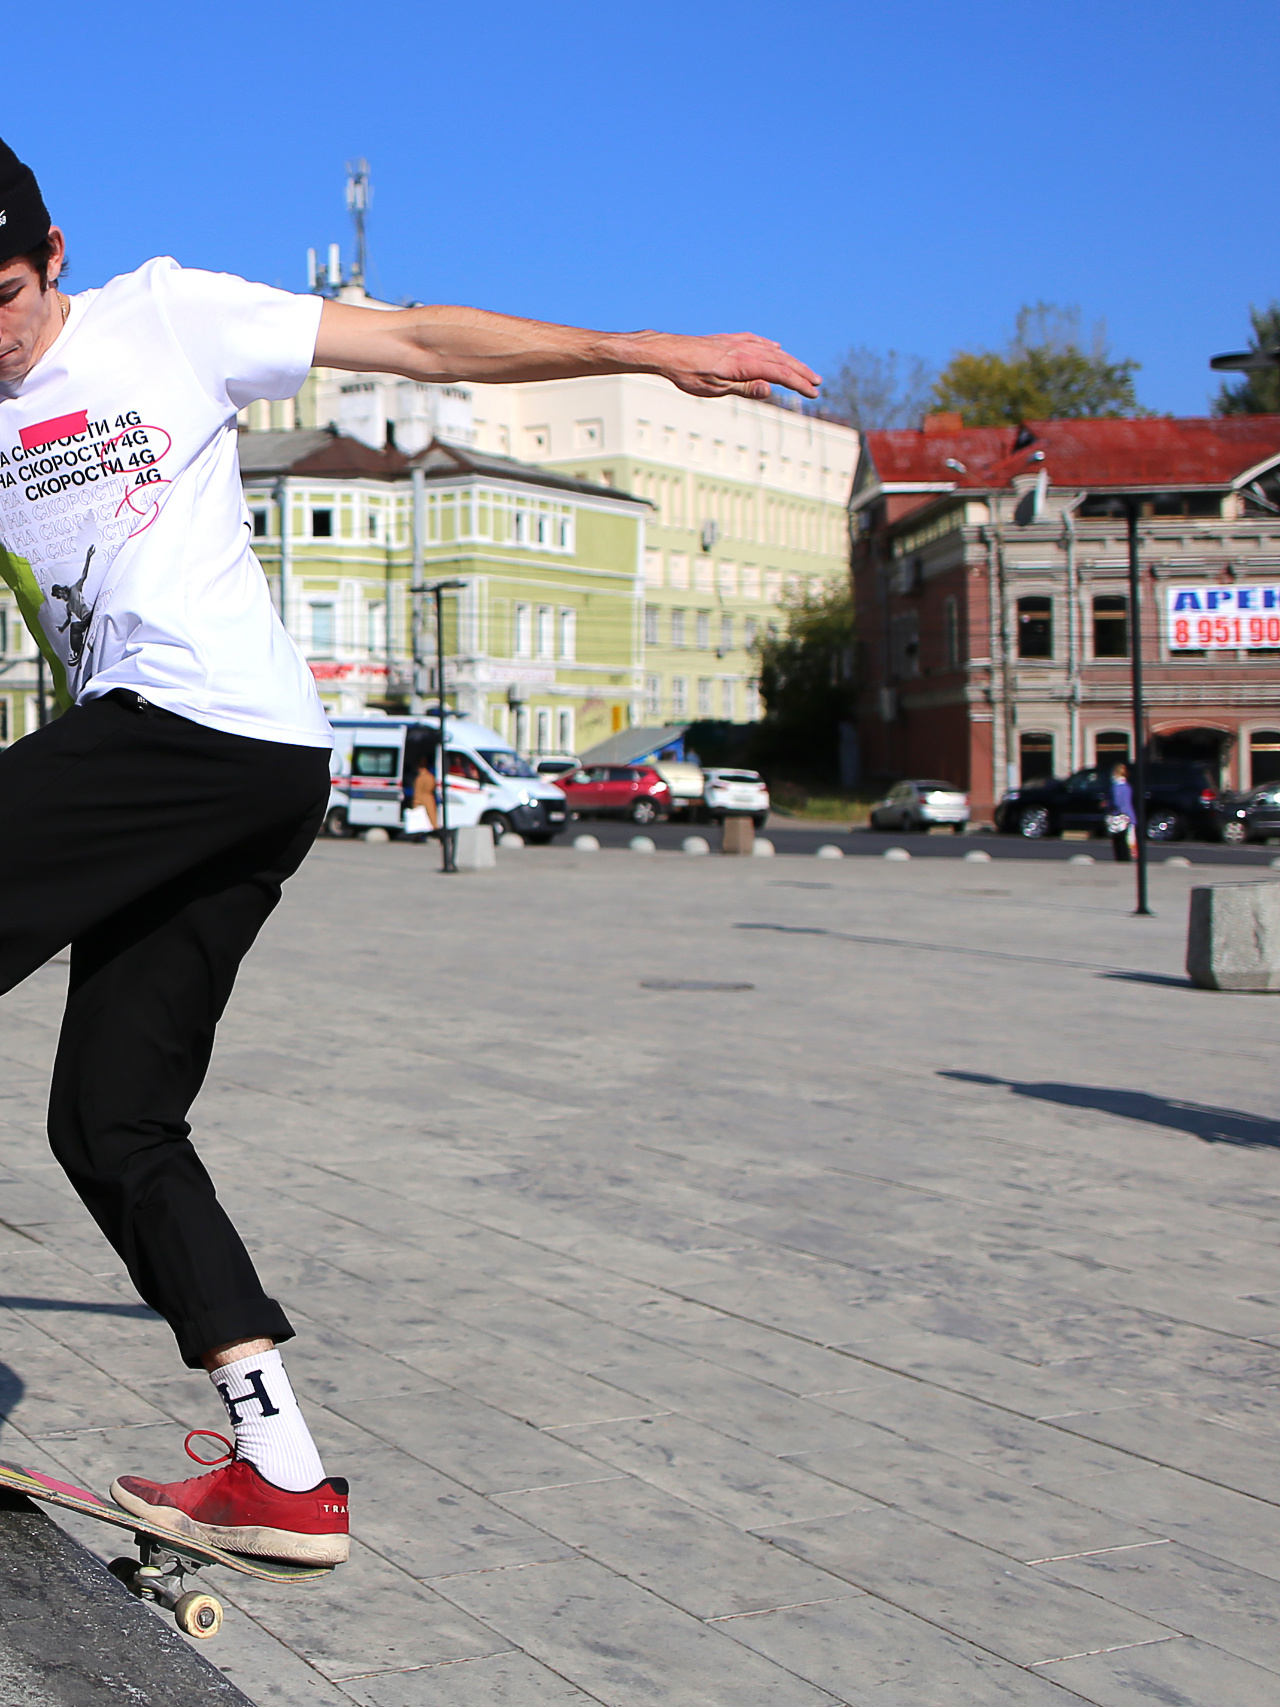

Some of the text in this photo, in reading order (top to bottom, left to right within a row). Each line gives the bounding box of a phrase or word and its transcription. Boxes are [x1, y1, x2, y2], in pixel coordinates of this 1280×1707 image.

[115, 410, 142, 429] 4G
[18, 438, 117, 482] СКОРОСТИ
[121, 429, 149, 448] 4G
[0, 491, 24, 511] НА
[25, 457, 124, 501] СКОРОСТИ
[128, 448, 156, 468] 4G
[6, 510, 32, 530] НА
[32, 476, 131, 521] СКОРОСТИ
[134, 468, 162, 486] 4G
[12, 529, 39, 549] НА
[1176, 618, 1280, 643] 8 951 90
[216, 1369, 280, 1426] H
[323, 1504, 349, 1514] TRA
